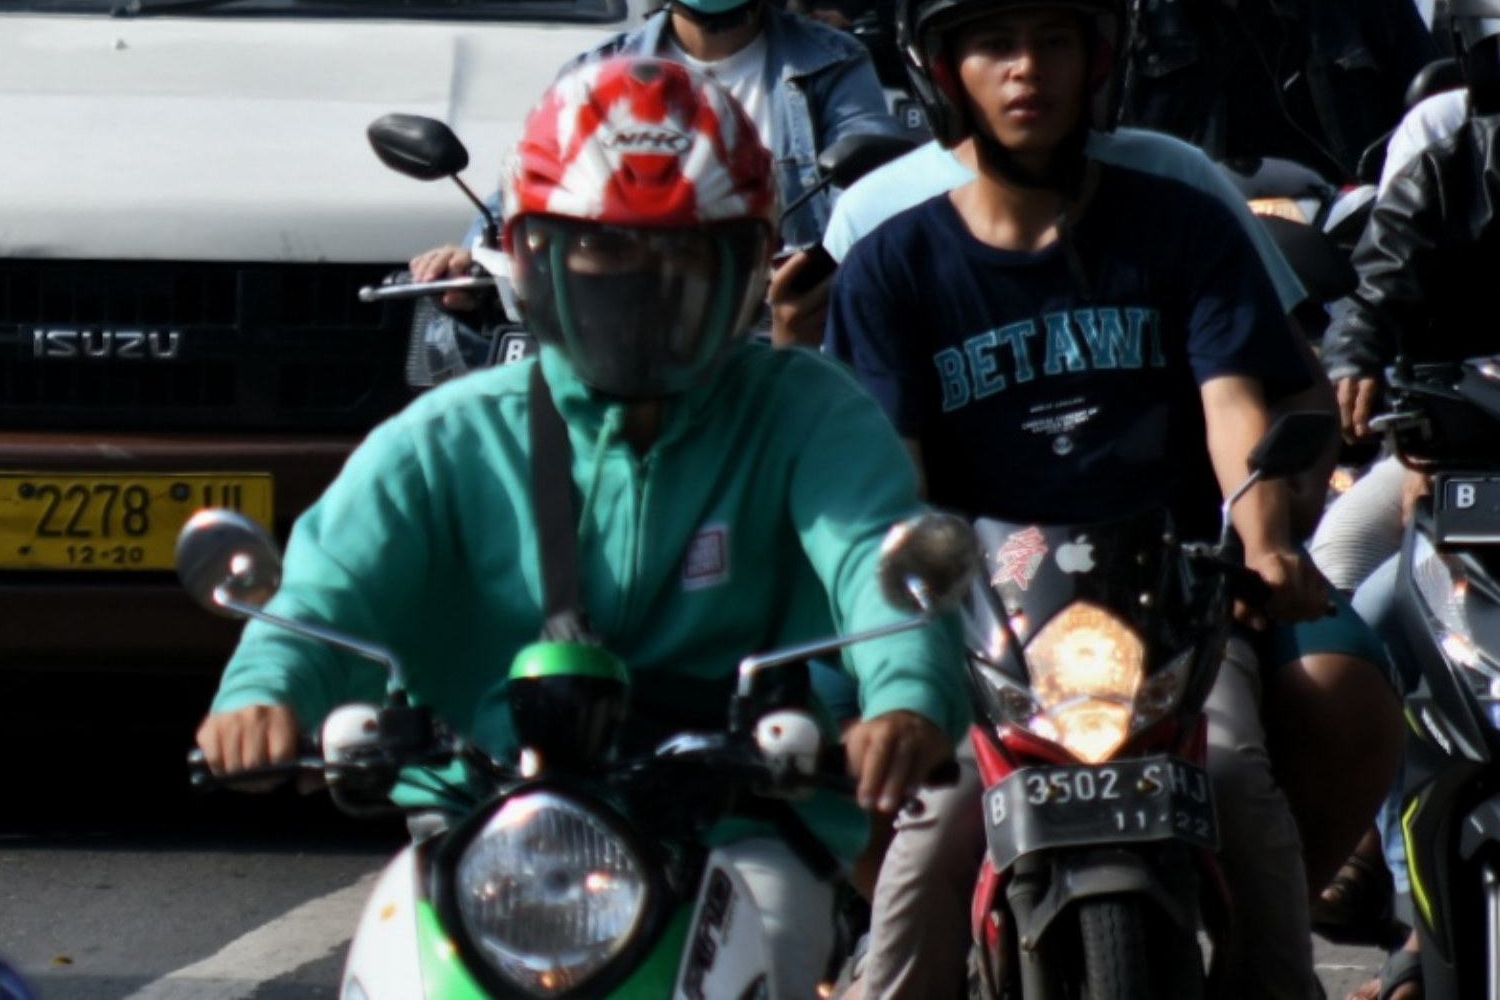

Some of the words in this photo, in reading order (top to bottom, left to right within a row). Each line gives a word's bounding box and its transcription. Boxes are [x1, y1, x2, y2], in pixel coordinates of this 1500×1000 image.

[907, 108, 921, 129] B
[33, 330, 180, 358] ISUZU
[506, 339, 526, 366] B
[1456, 483, 1476, 509] B
[35, 484, 151, 538] 2278
[989, 790, 1007, 827] B
[1025, 768, 1121, 805] 3502
[1142, 762, 1208, 805] SHJ
